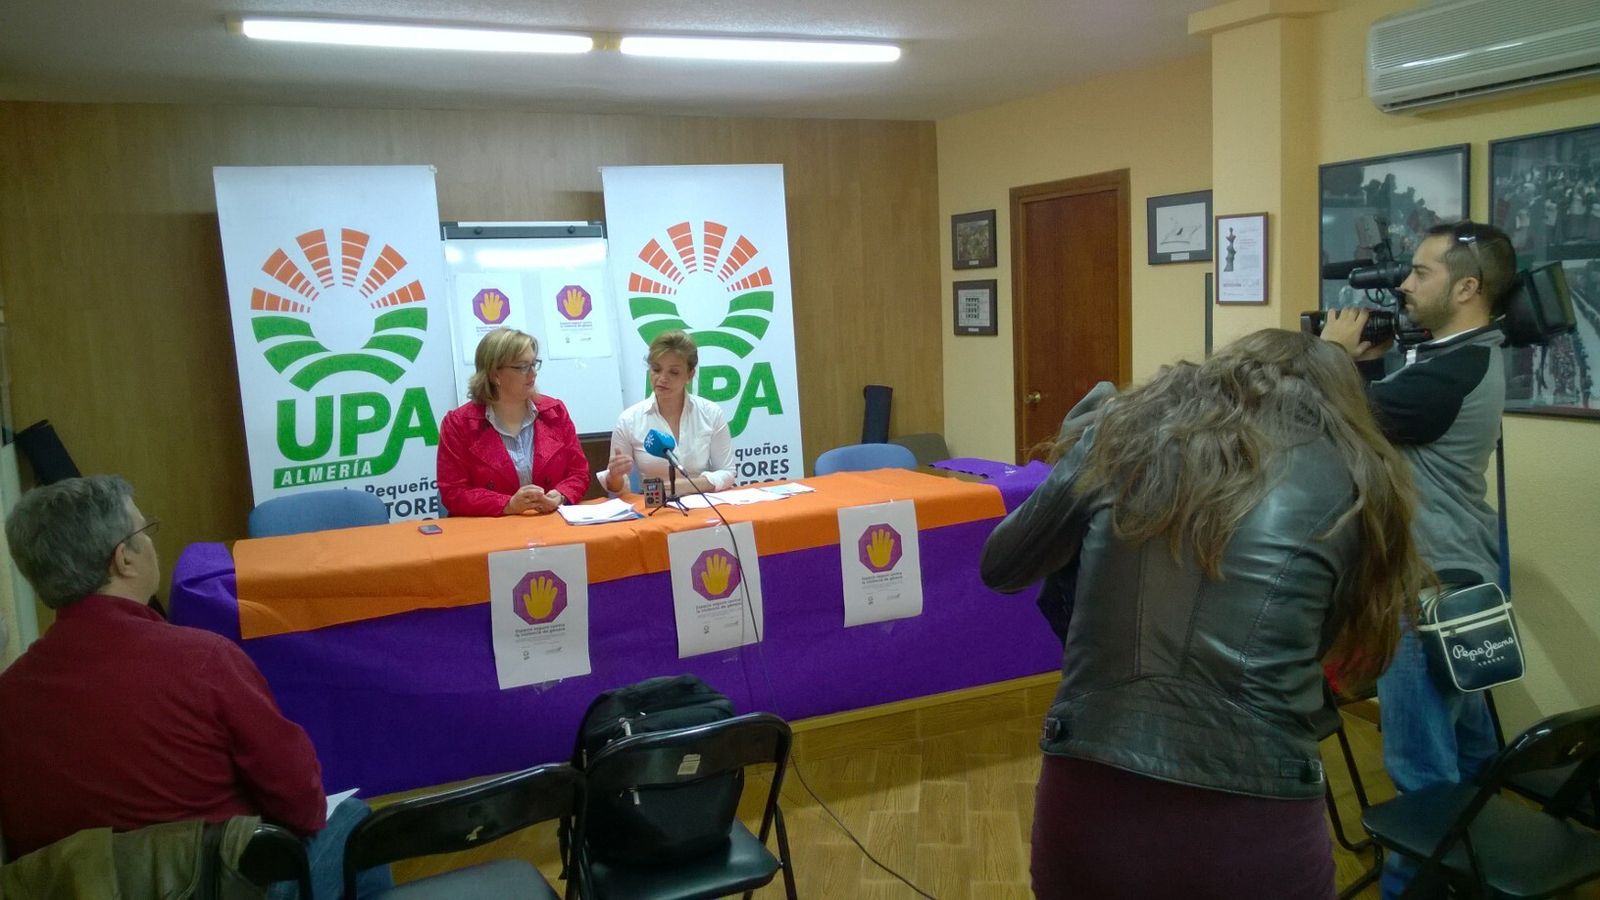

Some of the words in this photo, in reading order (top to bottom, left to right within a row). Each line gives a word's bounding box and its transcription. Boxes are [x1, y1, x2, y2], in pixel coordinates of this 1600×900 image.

[276, 387, 439, 475] UPA
[735, 442, 788, 461] queños
[280, 459, 373, 487] ALMERÍA
[735, 458, 790, 478] TORES
[365, 476, 439, 500] Pequeño
[1452, 645, 1485, 661] Pepe
[1483, 637, 1514, 658] Jeans
